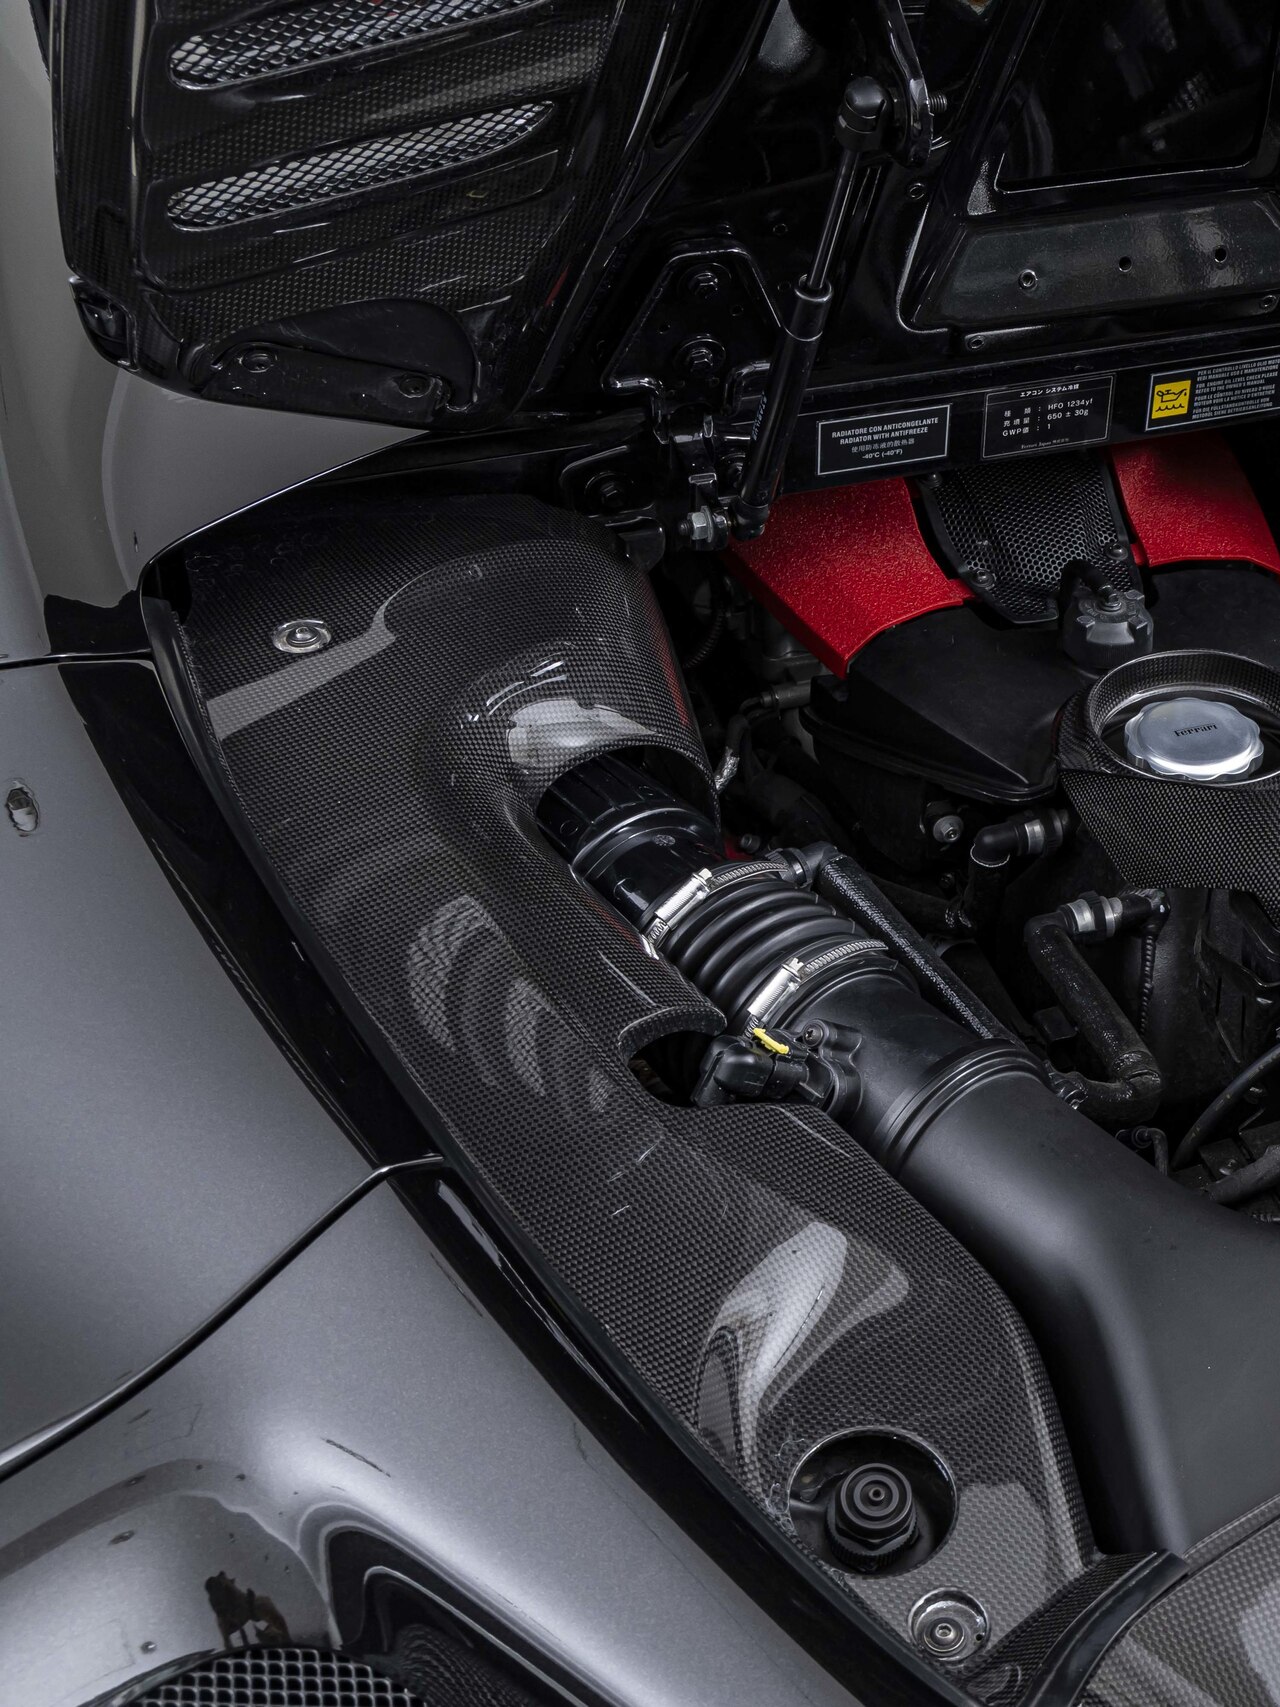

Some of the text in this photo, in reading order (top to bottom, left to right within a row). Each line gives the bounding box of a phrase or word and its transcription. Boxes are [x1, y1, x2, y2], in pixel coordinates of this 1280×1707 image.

[1239, 362, 1257, 370] LIVELLO
[1246, 373, 1261, 381] CHECK
[1246, 378, 1265, 386] MANUAL
[1020, 390, 1043, 398] エアコン
[1047, 402, 1064, 411] HFO
[1067, 397, 1094, 407] 1234yf
[1047, 412, 1063, 420] 650
[1074, 408, 1089, 417] 30g
[832, 417, 939, 439] RADIATORE CON ANTICONGELANTE
[840, 426, 929, 445] RADIATOR WITH ANTIFREEZE
[862, 448, 903, 459] -40°C (-40°F)
[1173, 723, 1218, 737] Ferrari
